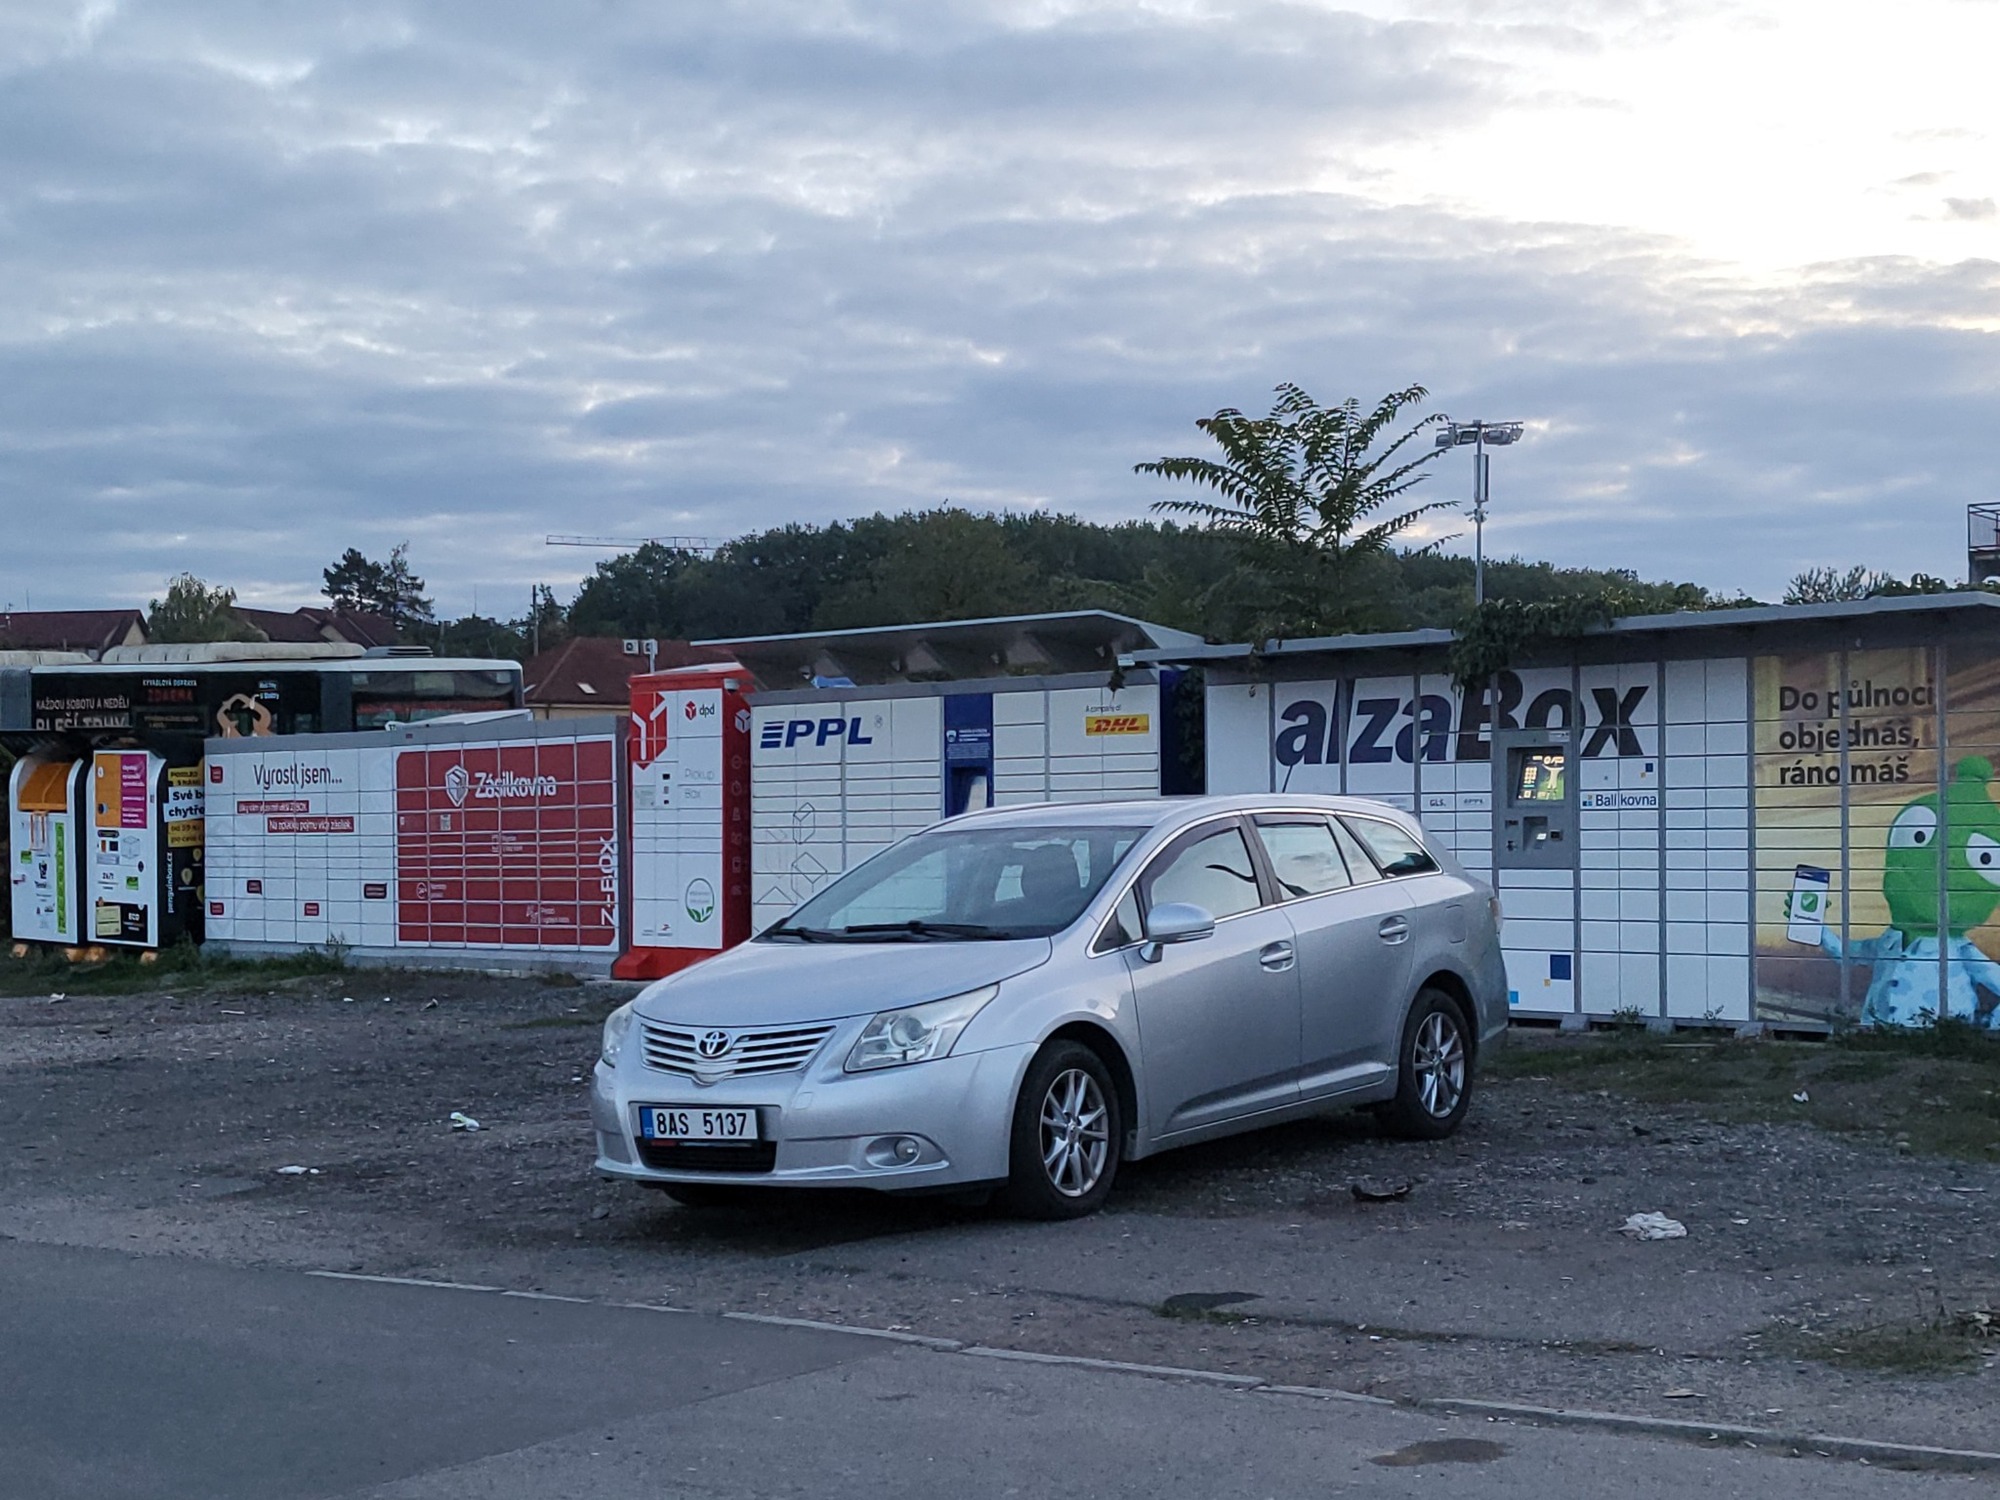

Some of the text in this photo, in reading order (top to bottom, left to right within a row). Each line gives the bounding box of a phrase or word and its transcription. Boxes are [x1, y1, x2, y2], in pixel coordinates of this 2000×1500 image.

[36, 694, 130, 710] KAŽDOU SOBOTU A NEDĚLI
[699, 703, 715, 718] dpd
[1779, 678, 1934, 718] Do půlnoci
[785, 716, 873, 748] PPL
[1094, 717, 1140, 732] DHL
[1275, 671, 1649, 766] alzaBox
[1779, 717, 1920, 756] objednáš,
[254, 763, 299, 790] Vyrostl
[1779, 755, 1909, 785] ráno máš
[172, 789, 193, 801] Své
[474, 771, 557, 799] Zásilkovna
[599, 836, 617, 926] Z-BOX
[656, 1112, 747, 1136] 8AS 5137
